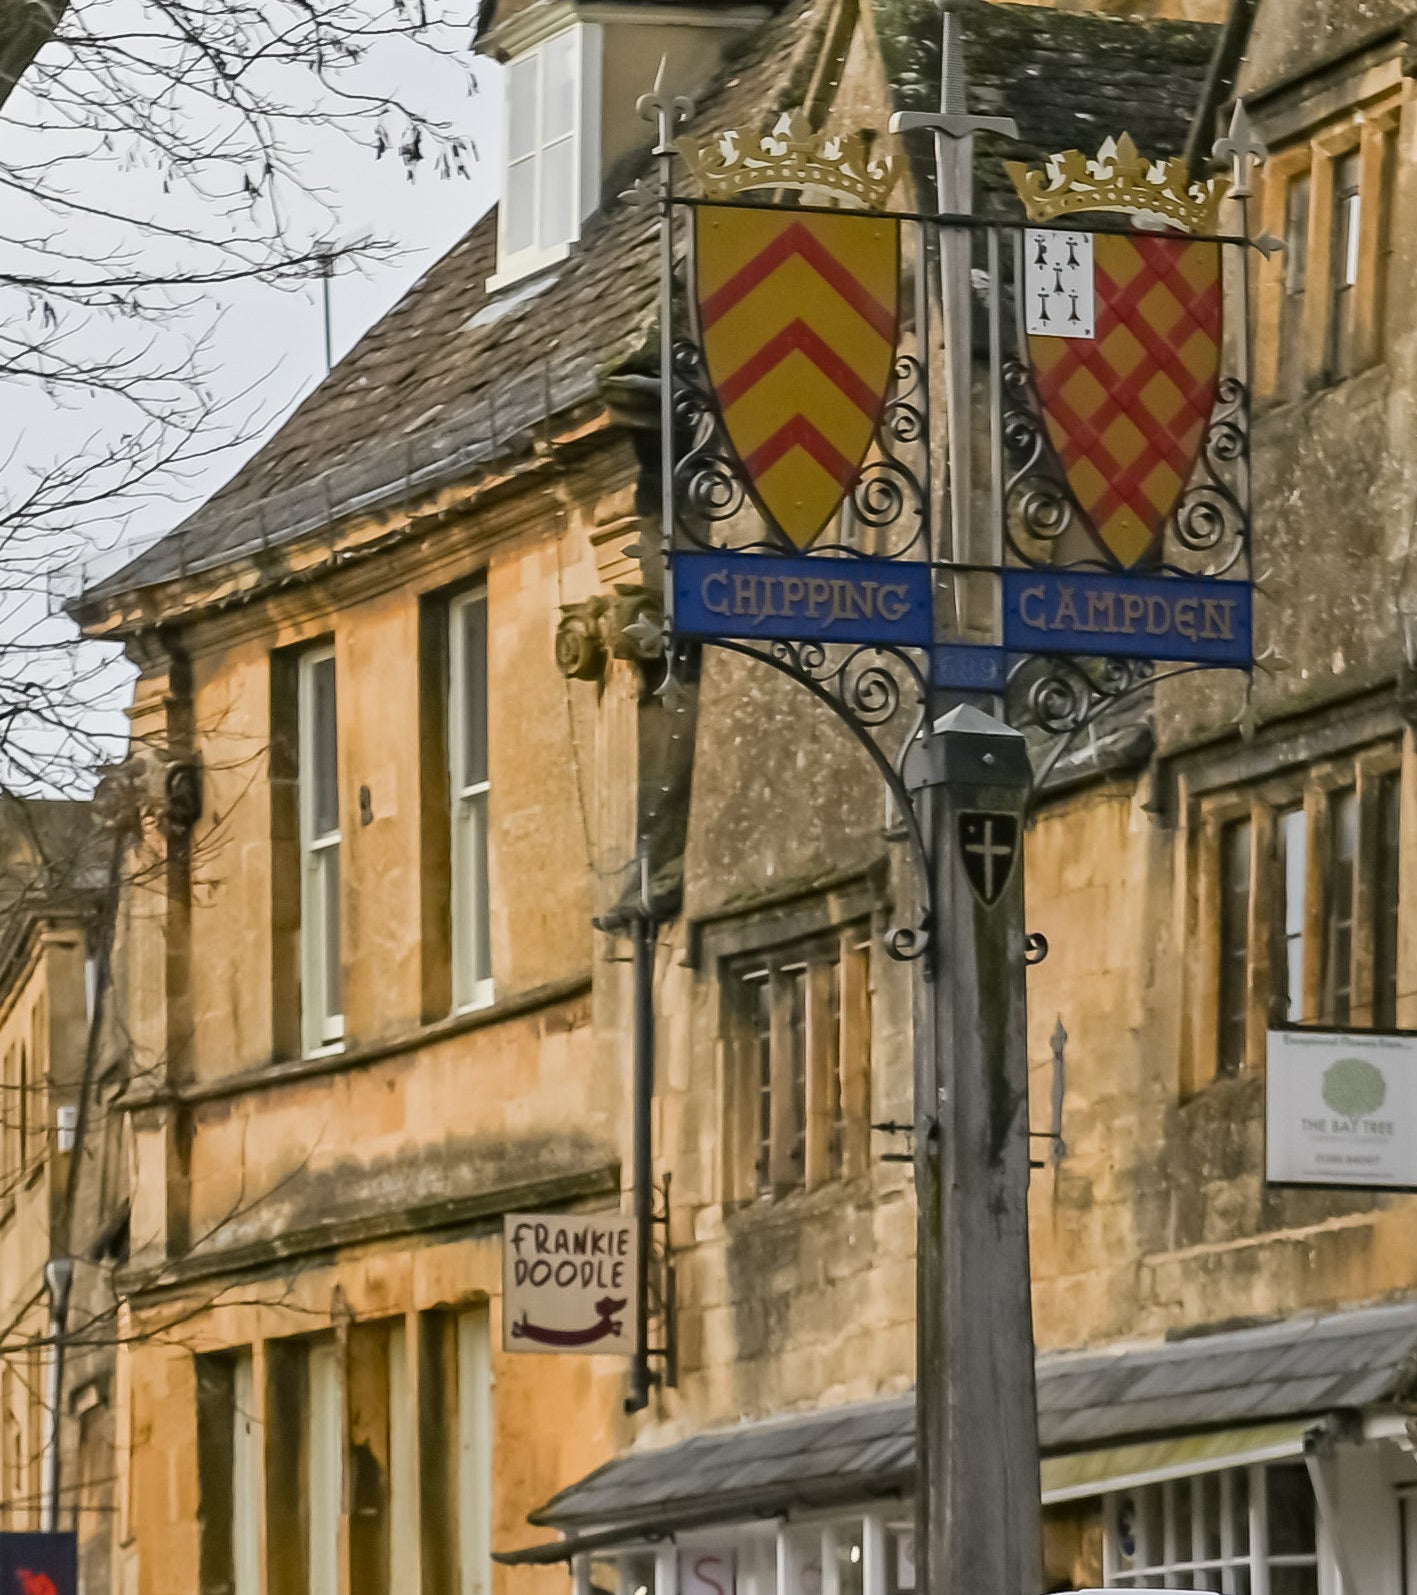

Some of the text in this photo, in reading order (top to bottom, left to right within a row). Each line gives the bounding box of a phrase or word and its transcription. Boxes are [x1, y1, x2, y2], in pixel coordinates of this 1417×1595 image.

[701, 568, 1238, 645] CHIPPING CAMPDEN
[511, 1222, 629, 1256] FRANKIE
[514, 1259, 625, 1288] DOODLE
